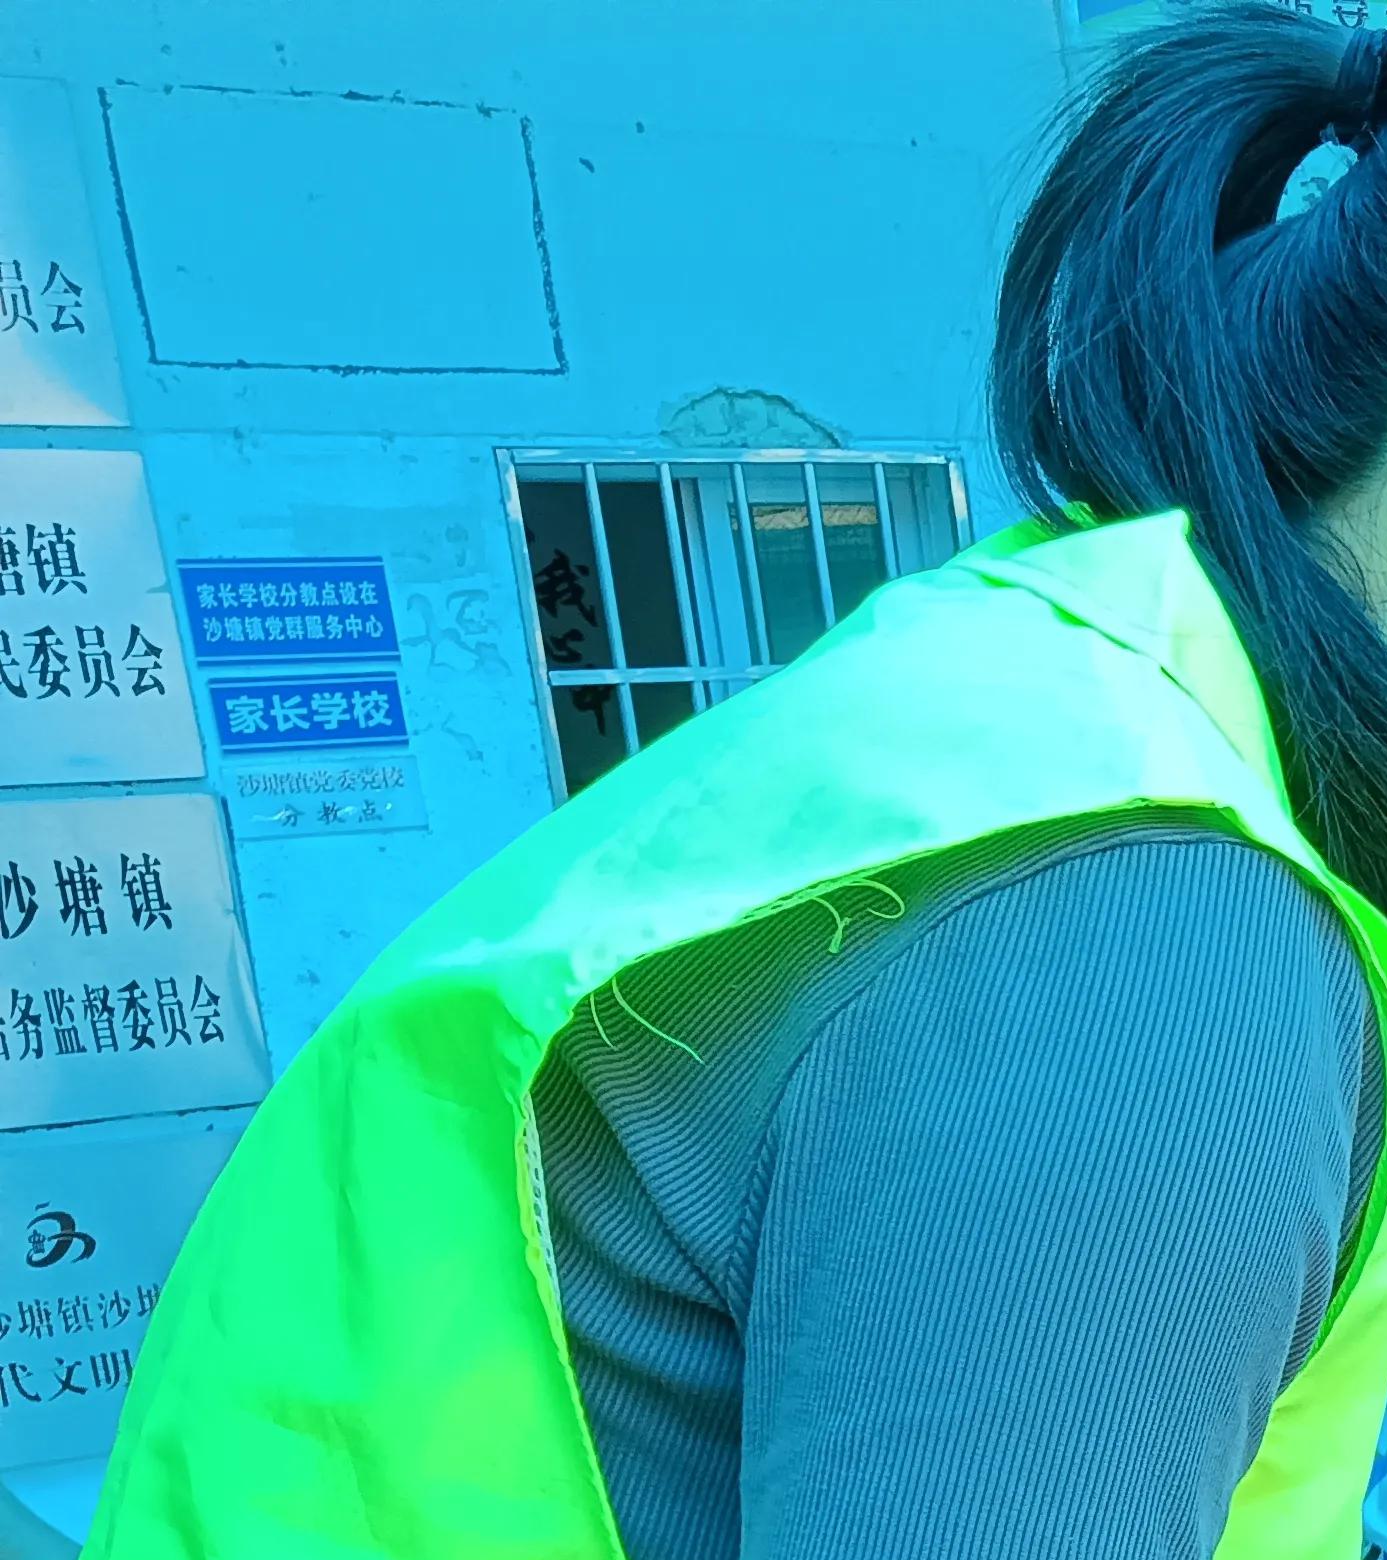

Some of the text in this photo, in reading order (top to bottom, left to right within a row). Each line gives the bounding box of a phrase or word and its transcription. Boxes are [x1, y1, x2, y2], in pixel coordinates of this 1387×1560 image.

[196, 581, 378, 609] 家长学校分教点设在
[203, 614, 384, 642] 沙塘镇党群服务中心
[225, 690, 392, 734] 家长学校
[0, 852, 173, 940] 沙塘镇
[0, 974, 225, 1061] 务监督委员会
